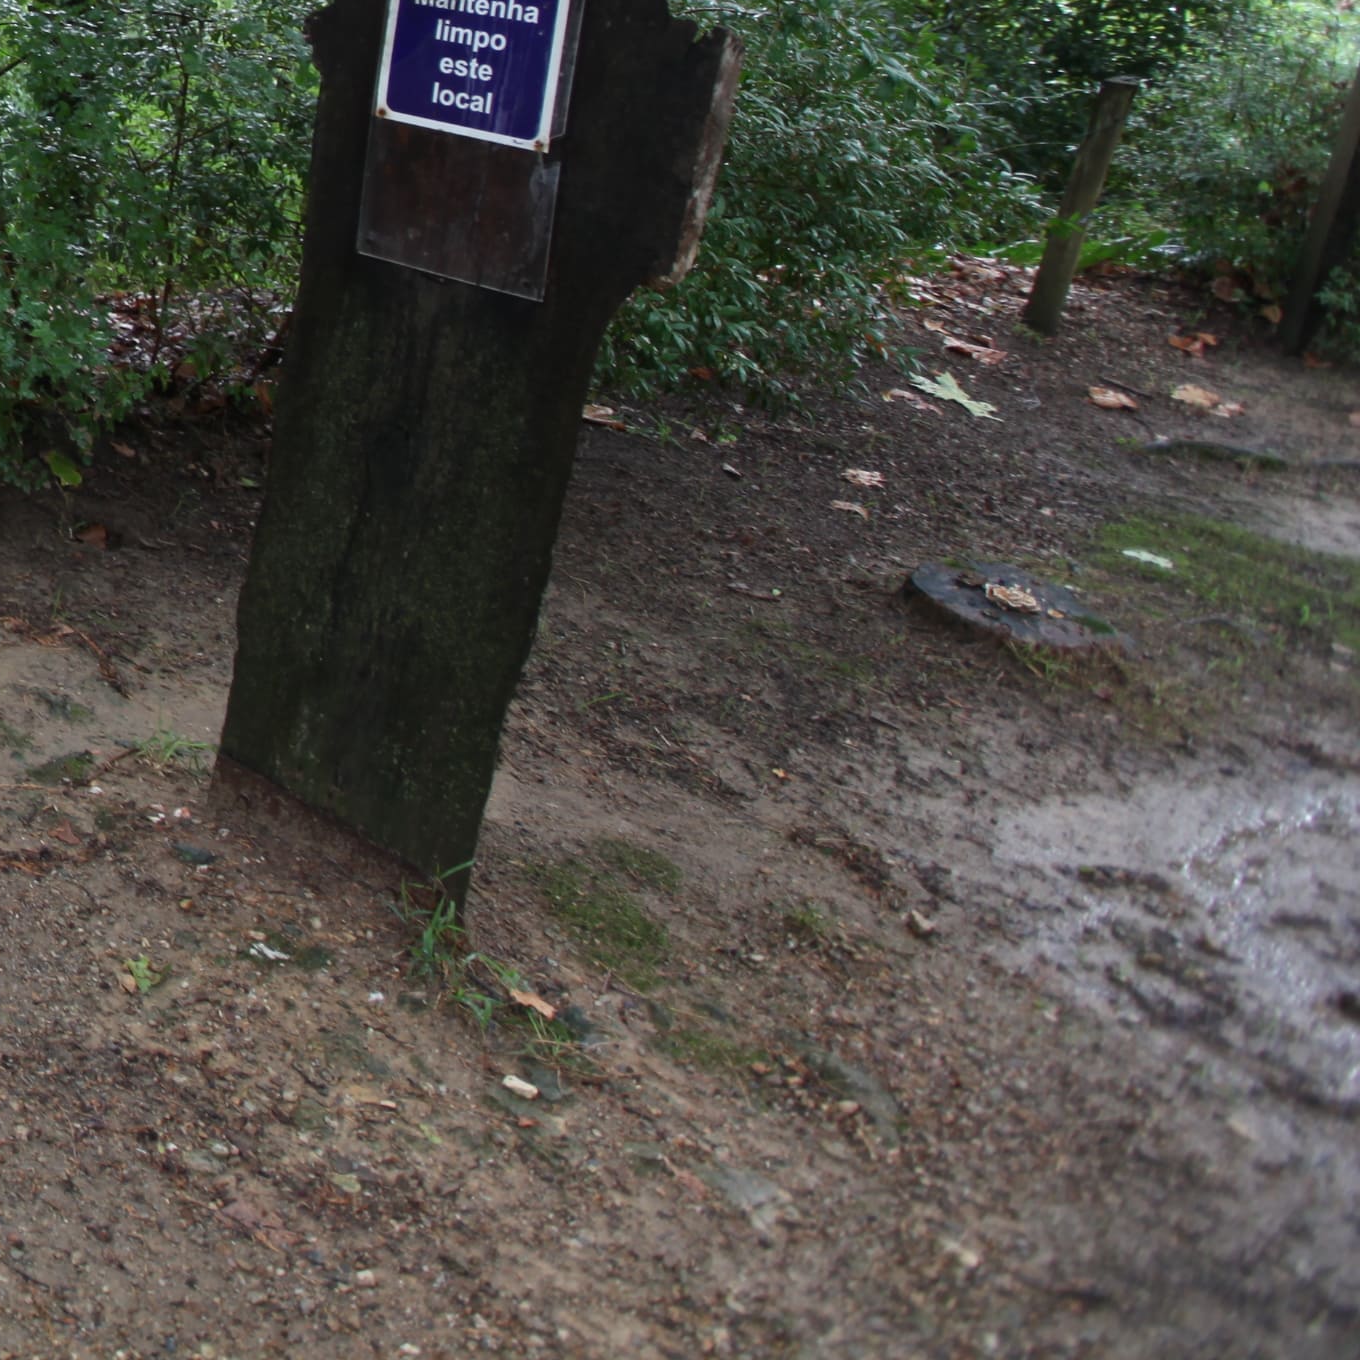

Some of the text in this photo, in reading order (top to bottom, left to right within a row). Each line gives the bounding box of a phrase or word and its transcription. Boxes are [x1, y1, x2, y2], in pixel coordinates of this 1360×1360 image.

[435, 19, 507, 53] limpo
[439, 56, 493, 81] este
[432, 82, 493, 114] local
